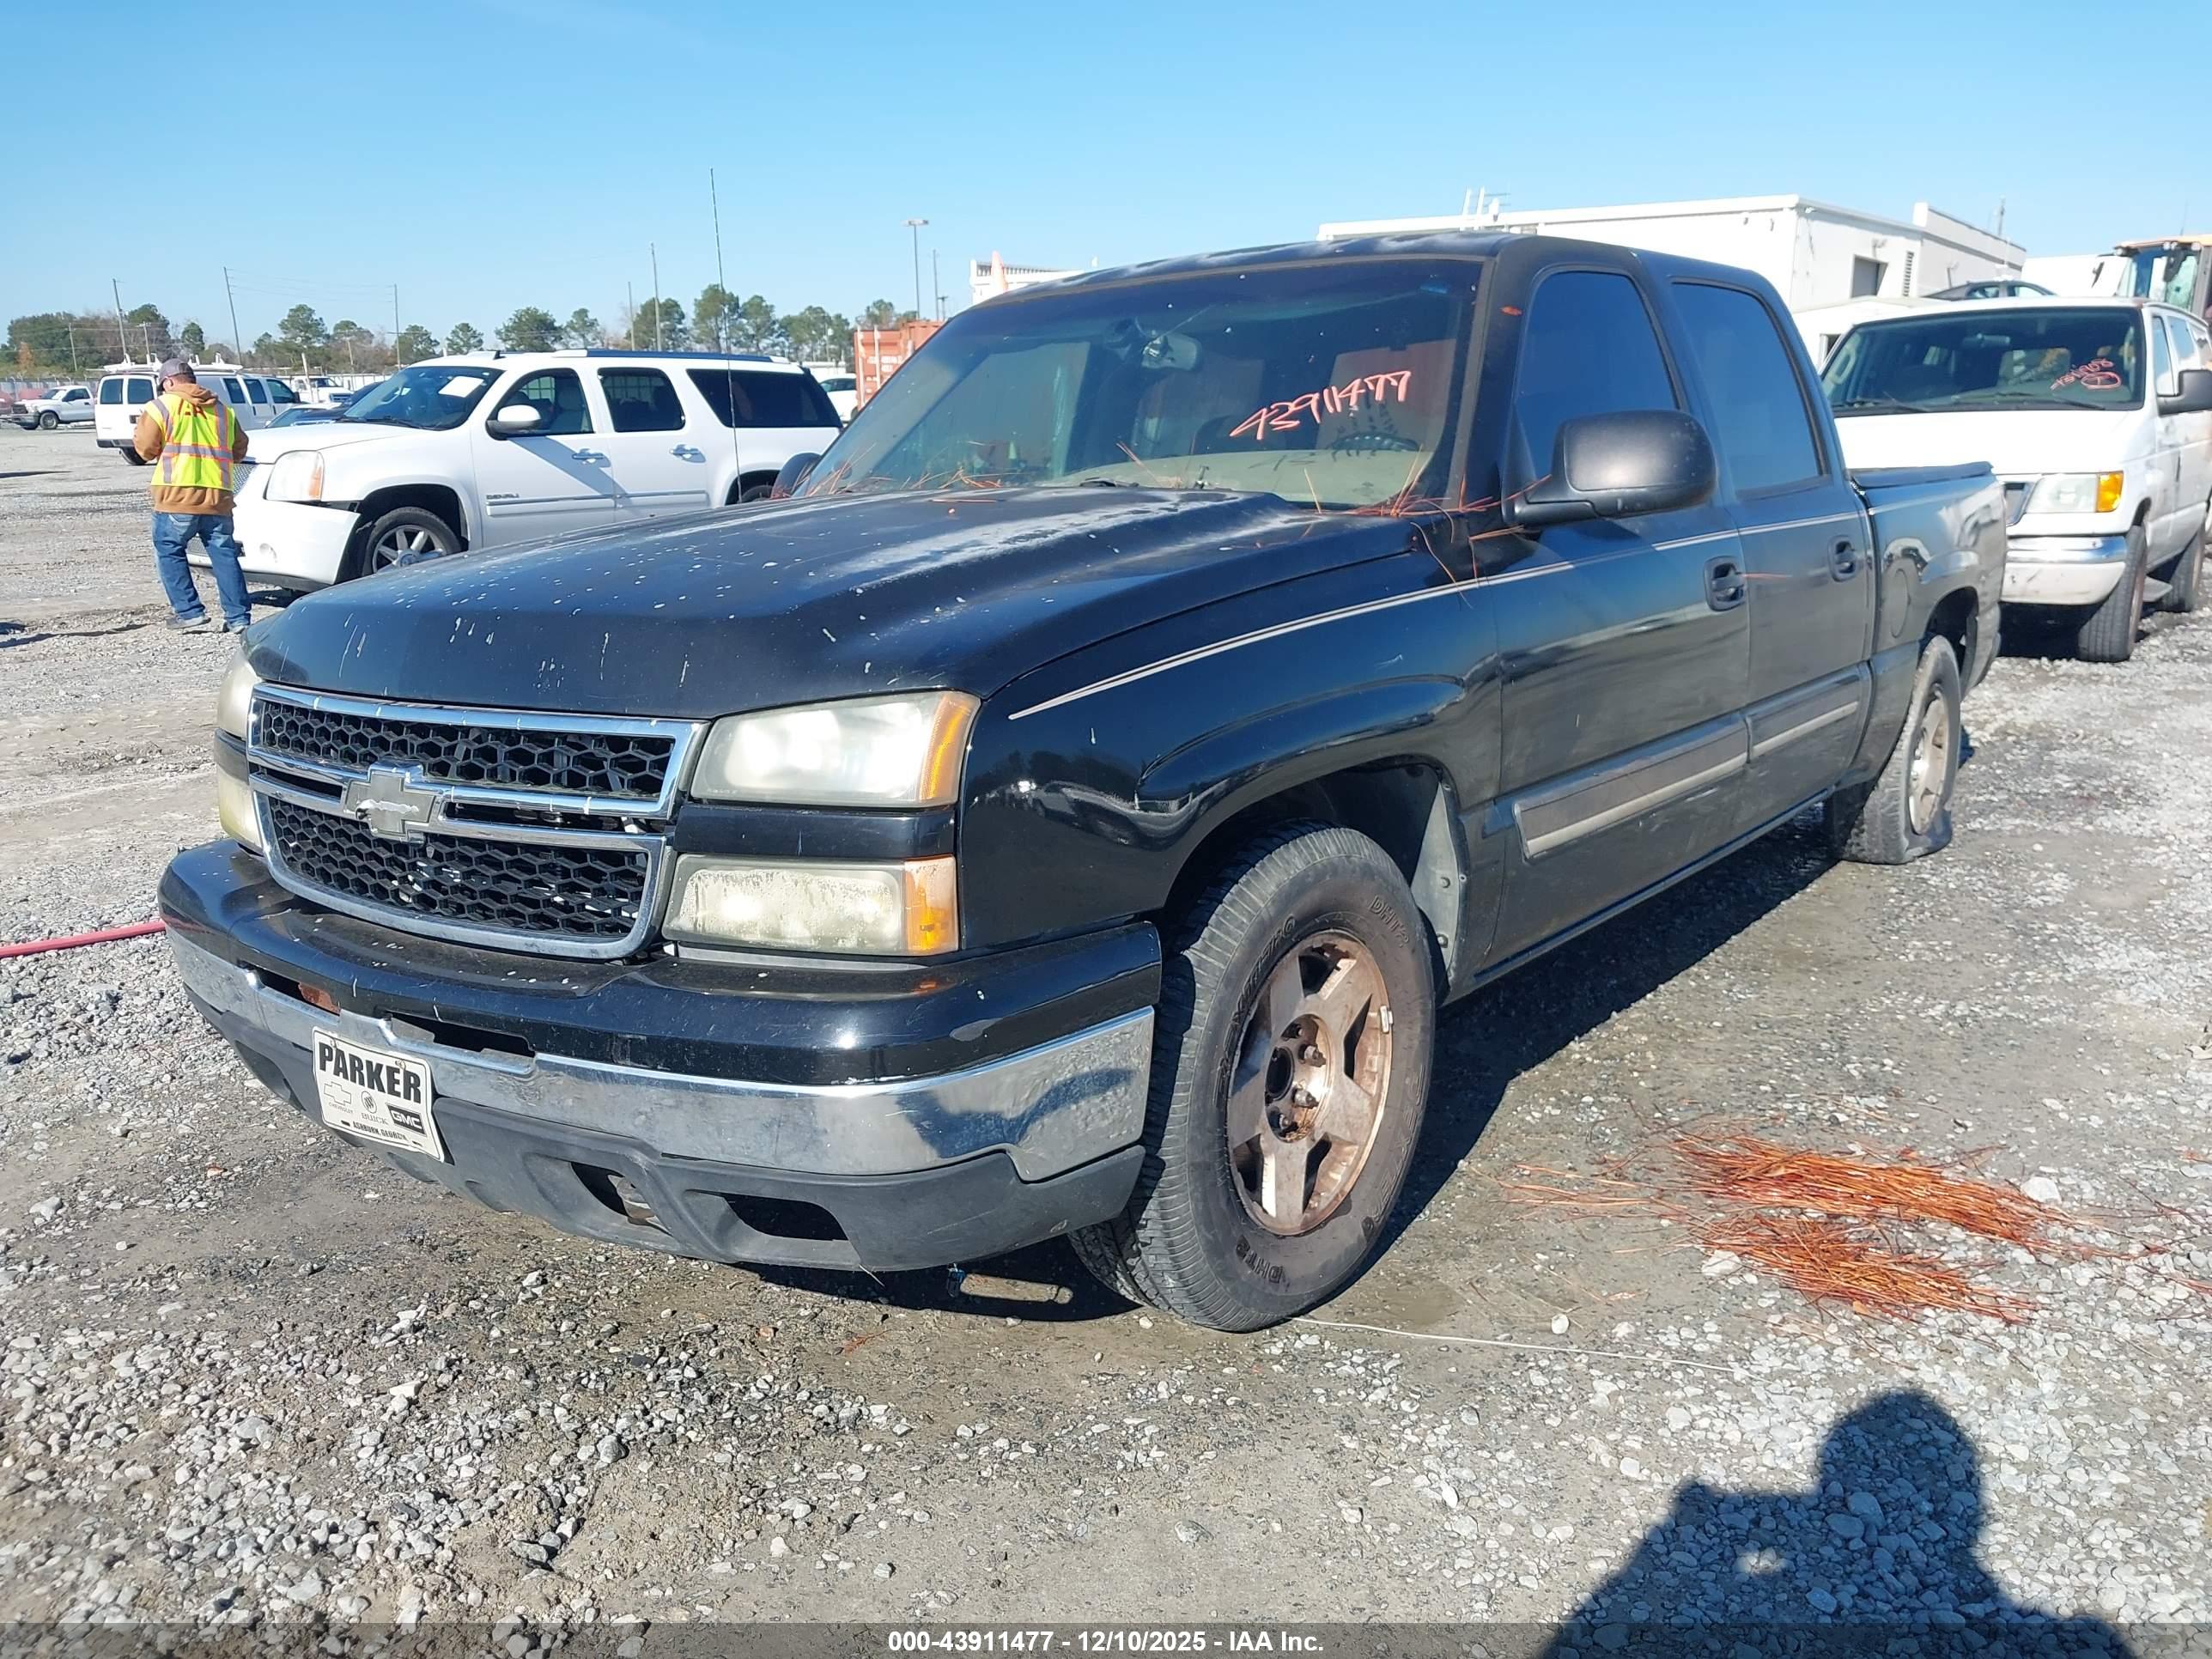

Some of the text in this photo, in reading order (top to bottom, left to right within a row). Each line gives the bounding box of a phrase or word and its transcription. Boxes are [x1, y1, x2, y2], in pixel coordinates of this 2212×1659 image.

[319, 1042, 422, 1104] PARKER
[362, 1113, 389, 1125] BUICK
[391, 1110, 422, 1129] GMC
